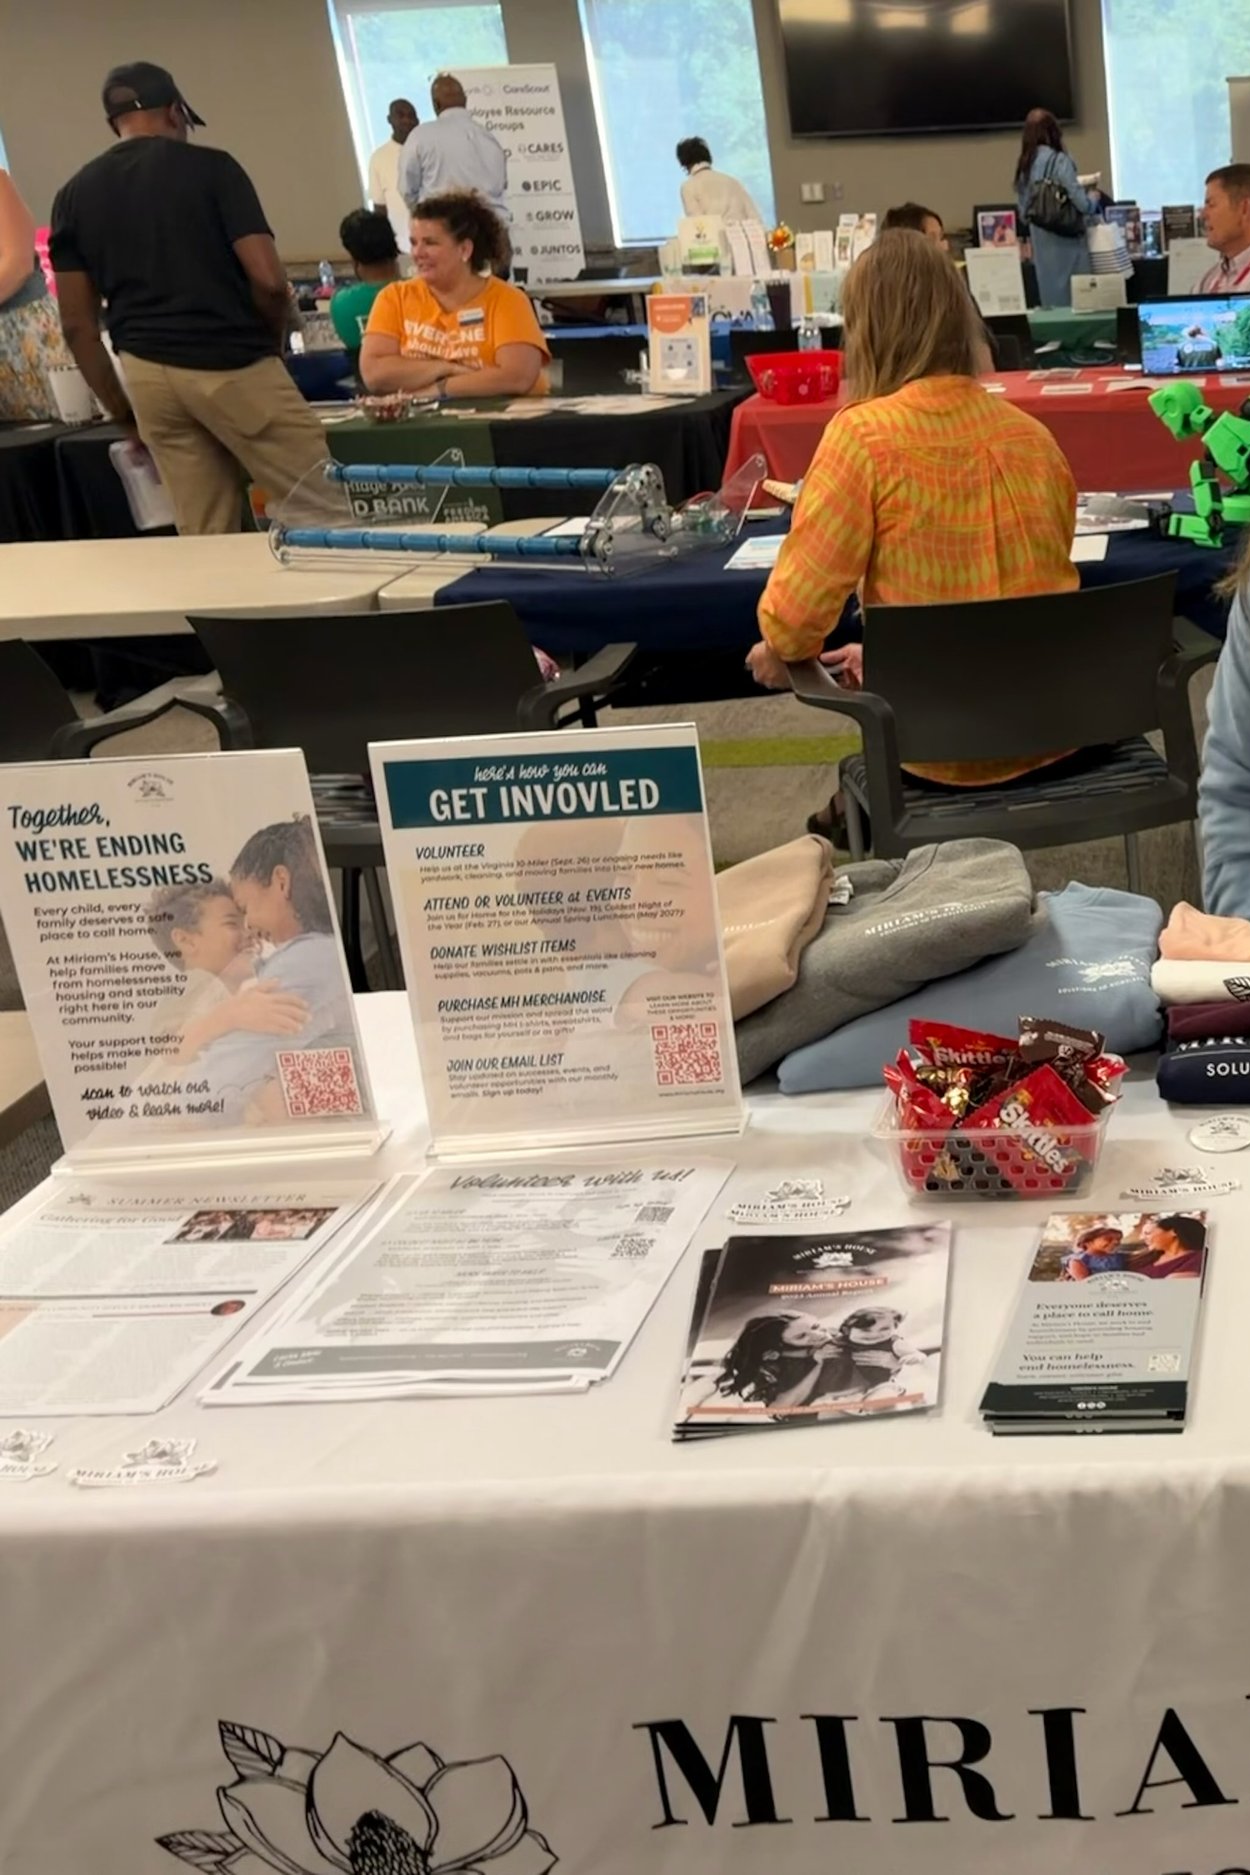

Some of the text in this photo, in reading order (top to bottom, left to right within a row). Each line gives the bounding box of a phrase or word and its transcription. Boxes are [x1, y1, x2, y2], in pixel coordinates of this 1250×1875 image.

[505, 106, 555, 116] Resource
[485, 121, 525, 132] Groups
[527, 143, 564, 154] CARES
[533, 180, 562, 191] EPIC
[535, 211, 574, 222] GROW
[539, 244, 581, 256] JUNTOS
[373, 497, 430, 515] BANK
[473, 762, 607, 782] here's how you can
[429, 778, 660, 821] GET INVOVLED
[8, 803, 110, 834] Together,
[15, 833, 186, 862] WE'RE ENDING
[415, 843, 485, 860] VOLUNTEER
[24, 863, 213, 893] HOMELESSNESS
[423, 887, 632, 911] ATTEND OR VOLUNTEER at EVENTS
[34, 902, 141, 918] Every child, every
[37, 911, 174, 929] family deserves a safe
[40, 930, 73, 943] place
[78, 928, 90, 939] to
[93, 927, 115, 937] call
[46, 950, 183, 966] At Miriam's House, we
[430, 939, 577, 960] DONATE WISHLIST ITEMS
[50, 963, 165, 979] help families move
[53, 973, 187, 990] from homelessness to
[55, 985, 185, 1002] housing and stability
[438, 989, 606, 1012] PURCHASE MH MERCHANDISE
[59, 1000, 158, 1015] right here in our
[62, 1013, 135, 1025] community.
[68, 1033, 185, 1050] Your support today
[71, 1045, 180, 1062] helps make home
[74, 1061, 127, 1074] possible!
[446, 1052, 564, 1073] JOIN OUR EMAIL LIST
[81, 1079, 211, 1101] scan to watch our
[86, 1098, 225, 1120] video & learn more!
[1000, 1103, 1069, 1173] Skittles
[450, 1173, 576, 1189] Volunteer
[582, 1169, 643, 1187] with
[1036, 1301, 1148, 1311] Everyone deserves
[1043, 1312, 1076, 1321] place
[1092, 1310, 1115, 1318] call
[1023, 1353, 1047, 1361] You
[1074, 1352, 1103, 1362] help
[1018, 1363, 1044, 1371] end
